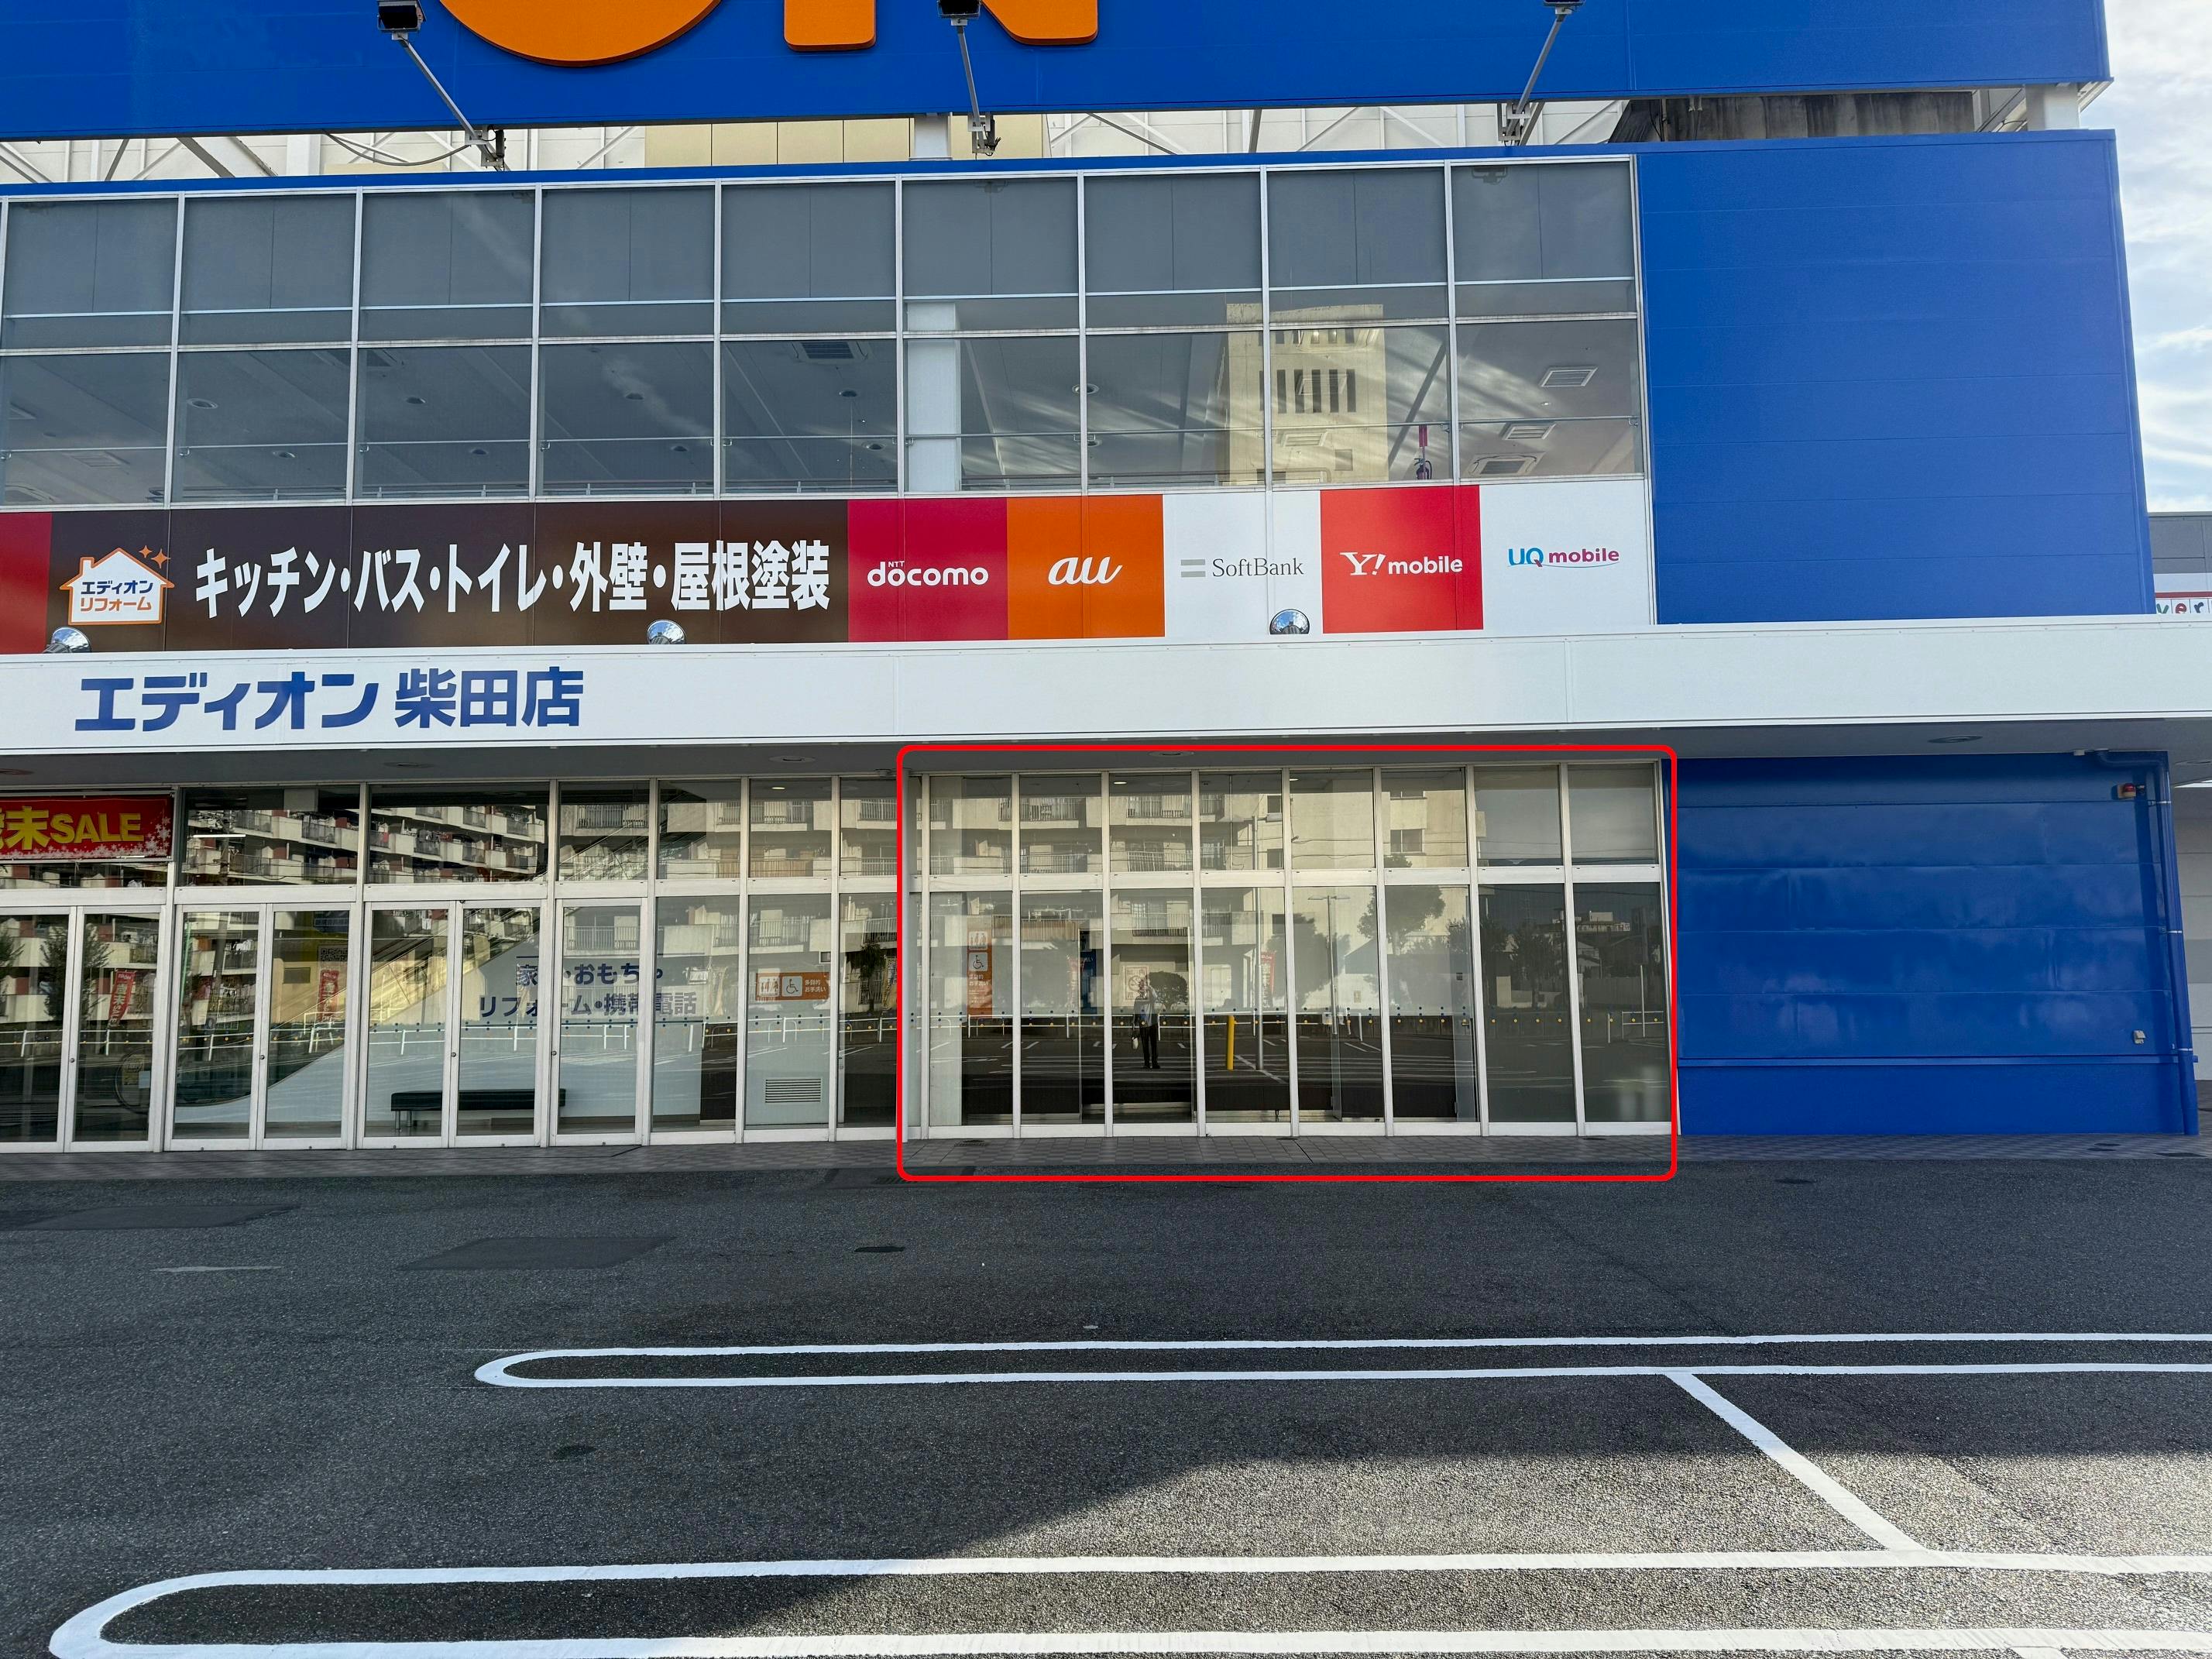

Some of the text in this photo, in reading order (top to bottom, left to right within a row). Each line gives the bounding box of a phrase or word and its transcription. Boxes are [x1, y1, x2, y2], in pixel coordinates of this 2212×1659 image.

[1211, 558, 1304, 578] SoftBank
[1507, 547, 1620, 568] UQ mobile
[867, 562, 989, 587] docomo
[1048, 555, 1123, 586] au
[81, 580, 153, 595] エディオン
[81, 596, 152, 612] リフォーム
[74, 666, 585, 733] エディオン 柴田店
[0, 805, 145, 850] 末SALE
